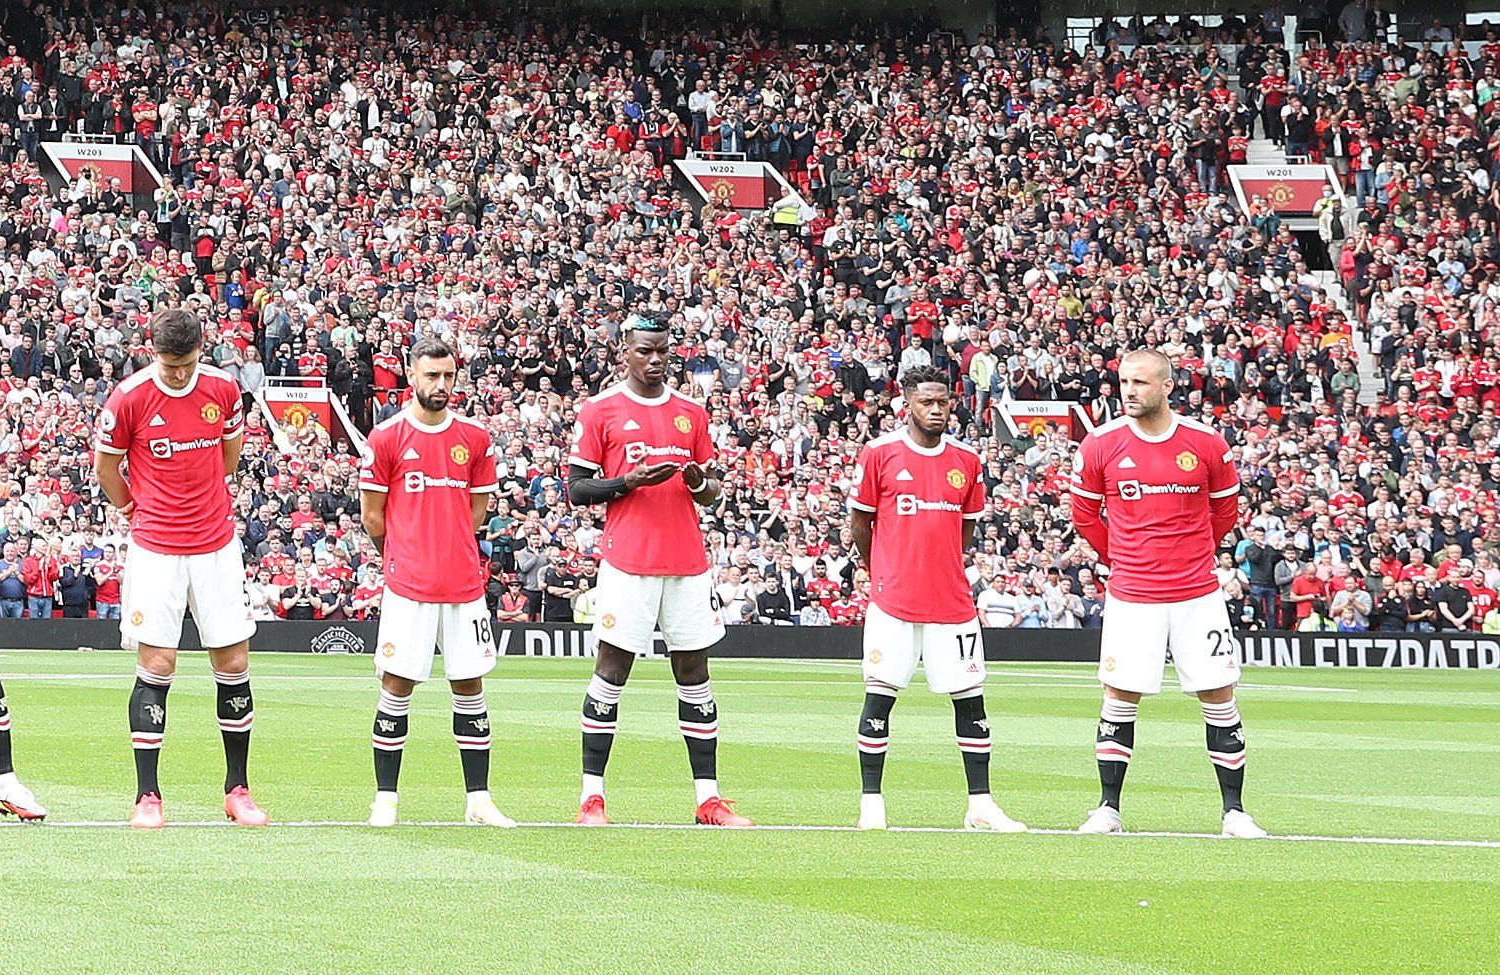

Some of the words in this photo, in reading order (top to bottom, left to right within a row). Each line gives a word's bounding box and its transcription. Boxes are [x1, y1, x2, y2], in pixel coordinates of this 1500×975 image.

[77, 148, 102, 156] W203
[709, 165, 735, 173] W202
[1139, 483, 1200, 494] TeamViewer
[472, 617, 491, 645] 18
[956, 632, 977, 661] 17
[1207, 628, 1234, 657] 23
